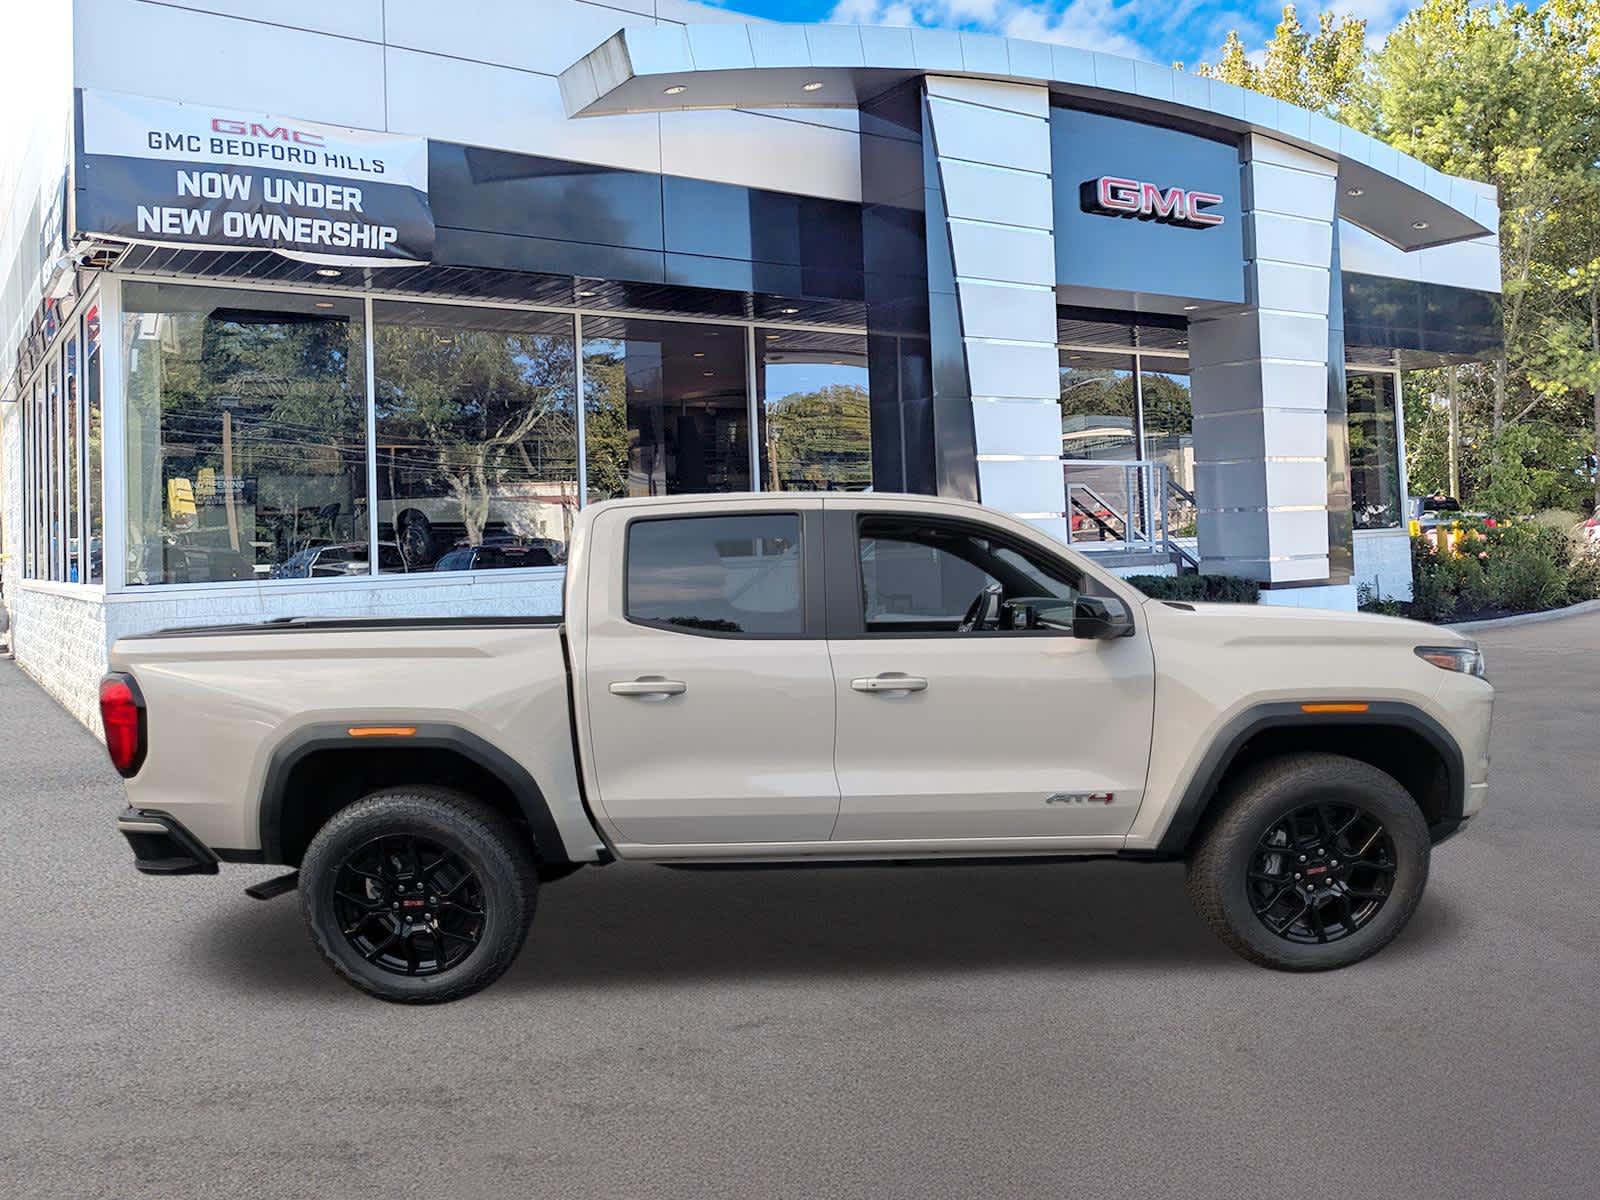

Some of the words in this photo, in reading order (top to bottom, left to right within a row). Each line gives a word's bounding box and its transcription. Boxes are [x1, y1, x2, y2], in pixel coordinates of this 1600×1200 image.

[148, 131, 201, 152] GMC
[210, 138, 316, 165] BEDFORD
[325, 153, 385, 174] HILLS
[211, 118, 326, 148] GMC
[176, 170, 252, 201] NOW
[263, 177, 363, 213] UNDER
[1097, 175, 1225, 225] GMC
[136, 205, 211, 236] NEW
[223, 210, 398, 250] OWNERSHIP
